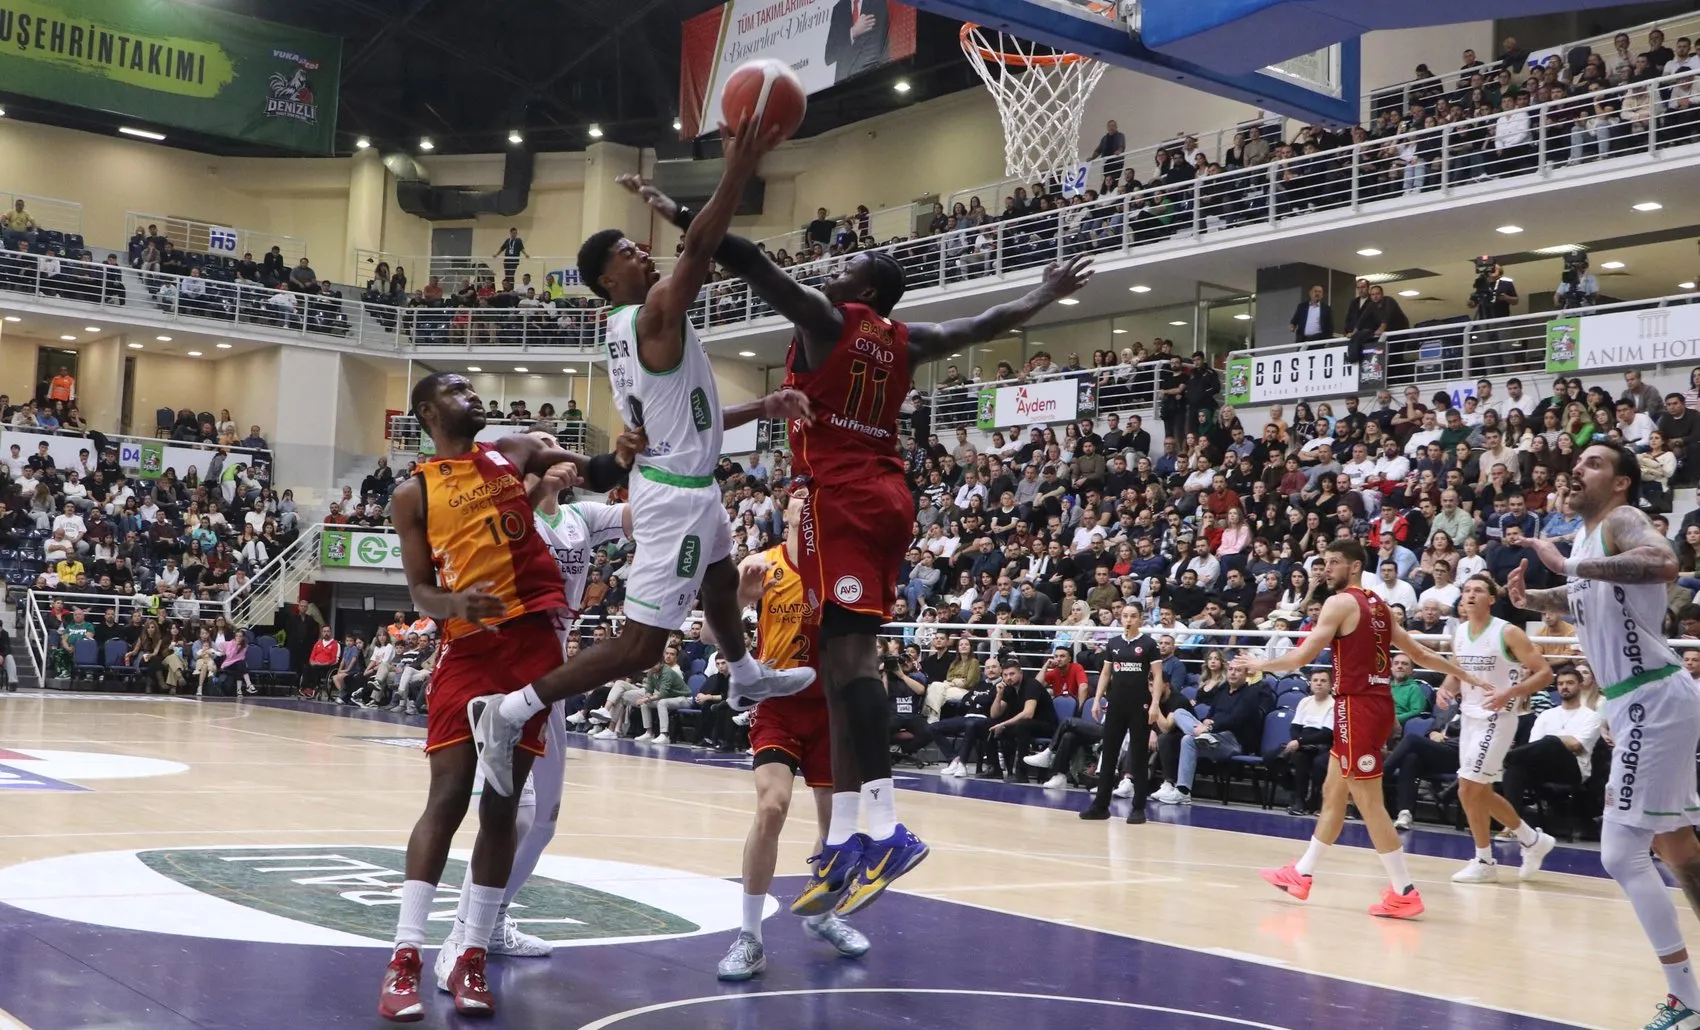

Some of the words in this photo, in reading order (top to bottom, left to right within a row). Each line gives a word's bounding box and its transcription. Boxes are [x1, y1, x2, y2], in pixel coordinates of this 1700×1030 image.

[737, 13, 755, 36] TÜM
[780, 7, 830, 40] Dilerim
[210, 229, 236, 252] H5
[1255, 352, 1352, 386] BOSTON
[844, 359, 889, 426] 11
[1016, 398, 1056, 416] Aydem
[122, 449, 140, 462] D4
[484, 511, 526, 546] 10
[681, 540, 695, 573] ABALI
[840, 584, 858, 595] AVS
[790, 634, 810, 662] 2
